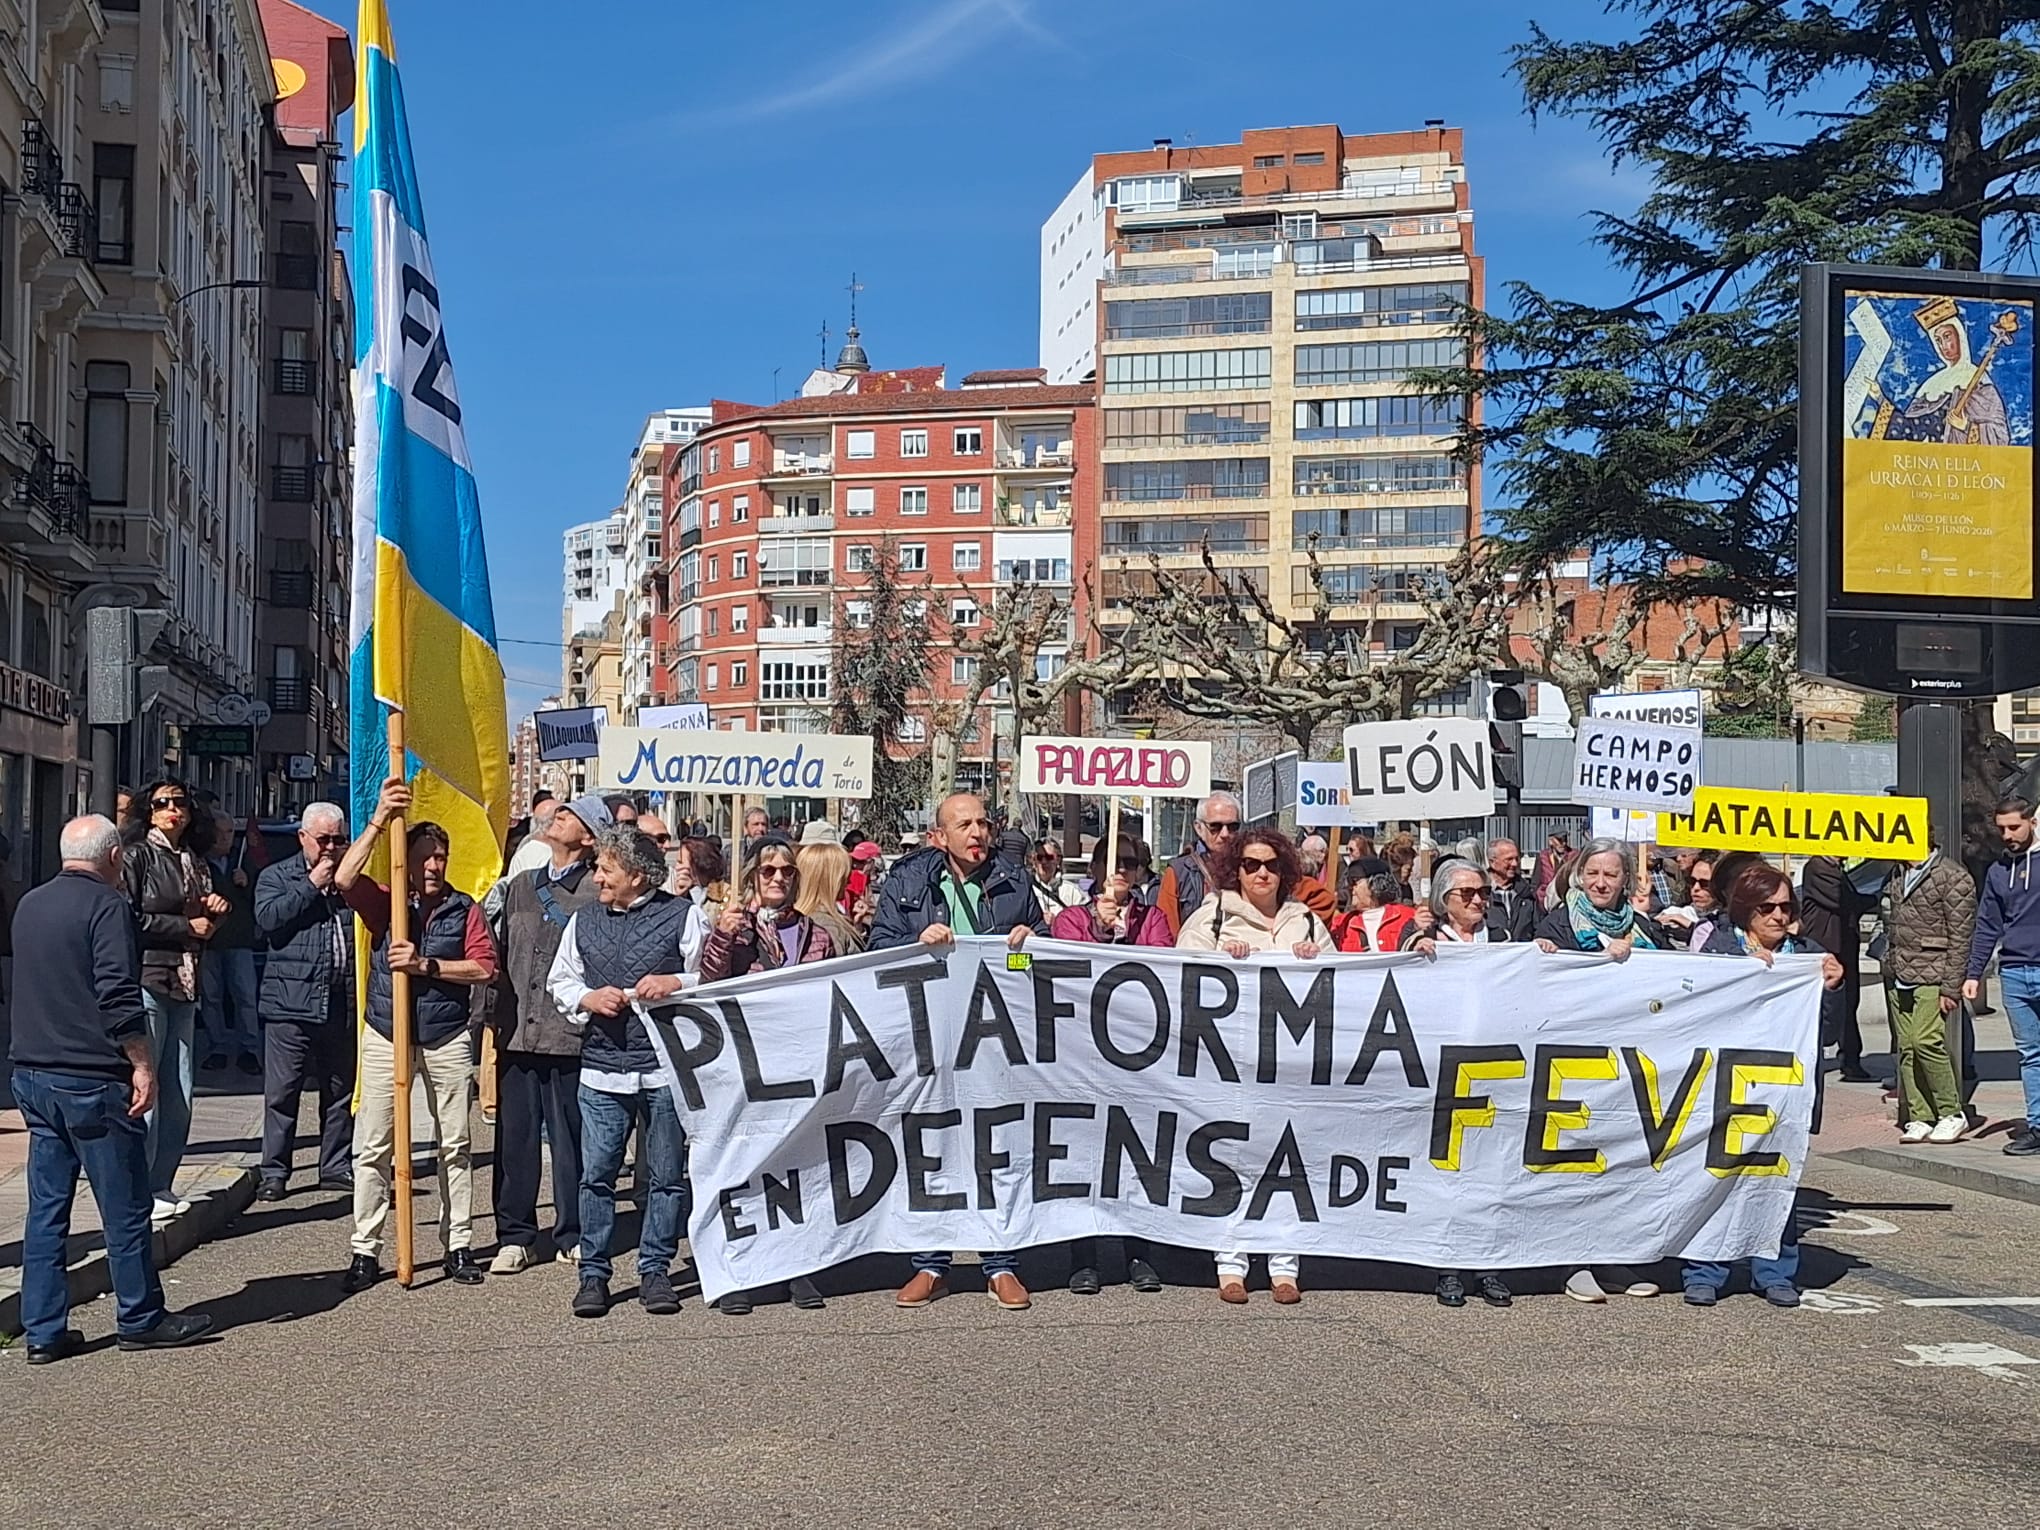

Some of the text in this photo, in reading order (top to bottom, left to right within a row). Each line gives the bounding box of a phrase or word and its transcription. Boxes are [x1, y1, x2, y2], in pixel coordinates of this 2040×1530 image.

[1893, 454, 1981, 472] REINA ELLA
[1870, 470, 1933, 487] URRACA
[1964, 473, 2006, 490] LEÓN
[1891, 523, 1925, 534] MARZO
[1942, 525, 1970, 536] JUNIO
[1971, 526, 1993, 536] 2026
[1902, 513, 1934, 524] MUSEO
[1935, 514, 1949, 525] DE
[1919, 679, 1962, 689] exteriorplus
[617, 737, 825, 789] Manzaneda
[842, 754, 855, 767] de
[1350, 729, 1486, 796] LEÓN
[1587, 733, 1693, 765] CAMPO
[1035, 745, 1191, 788] PALAZUELO
[1579, 763, 1693, 797] HERMOSO
[1670, 801, 1915, 845] MATALLANA
[647, 956, 1431, 1112] PLATAFORMA
[719, 1043, 1804, 1242] EN DEFENSA DE FEVE
